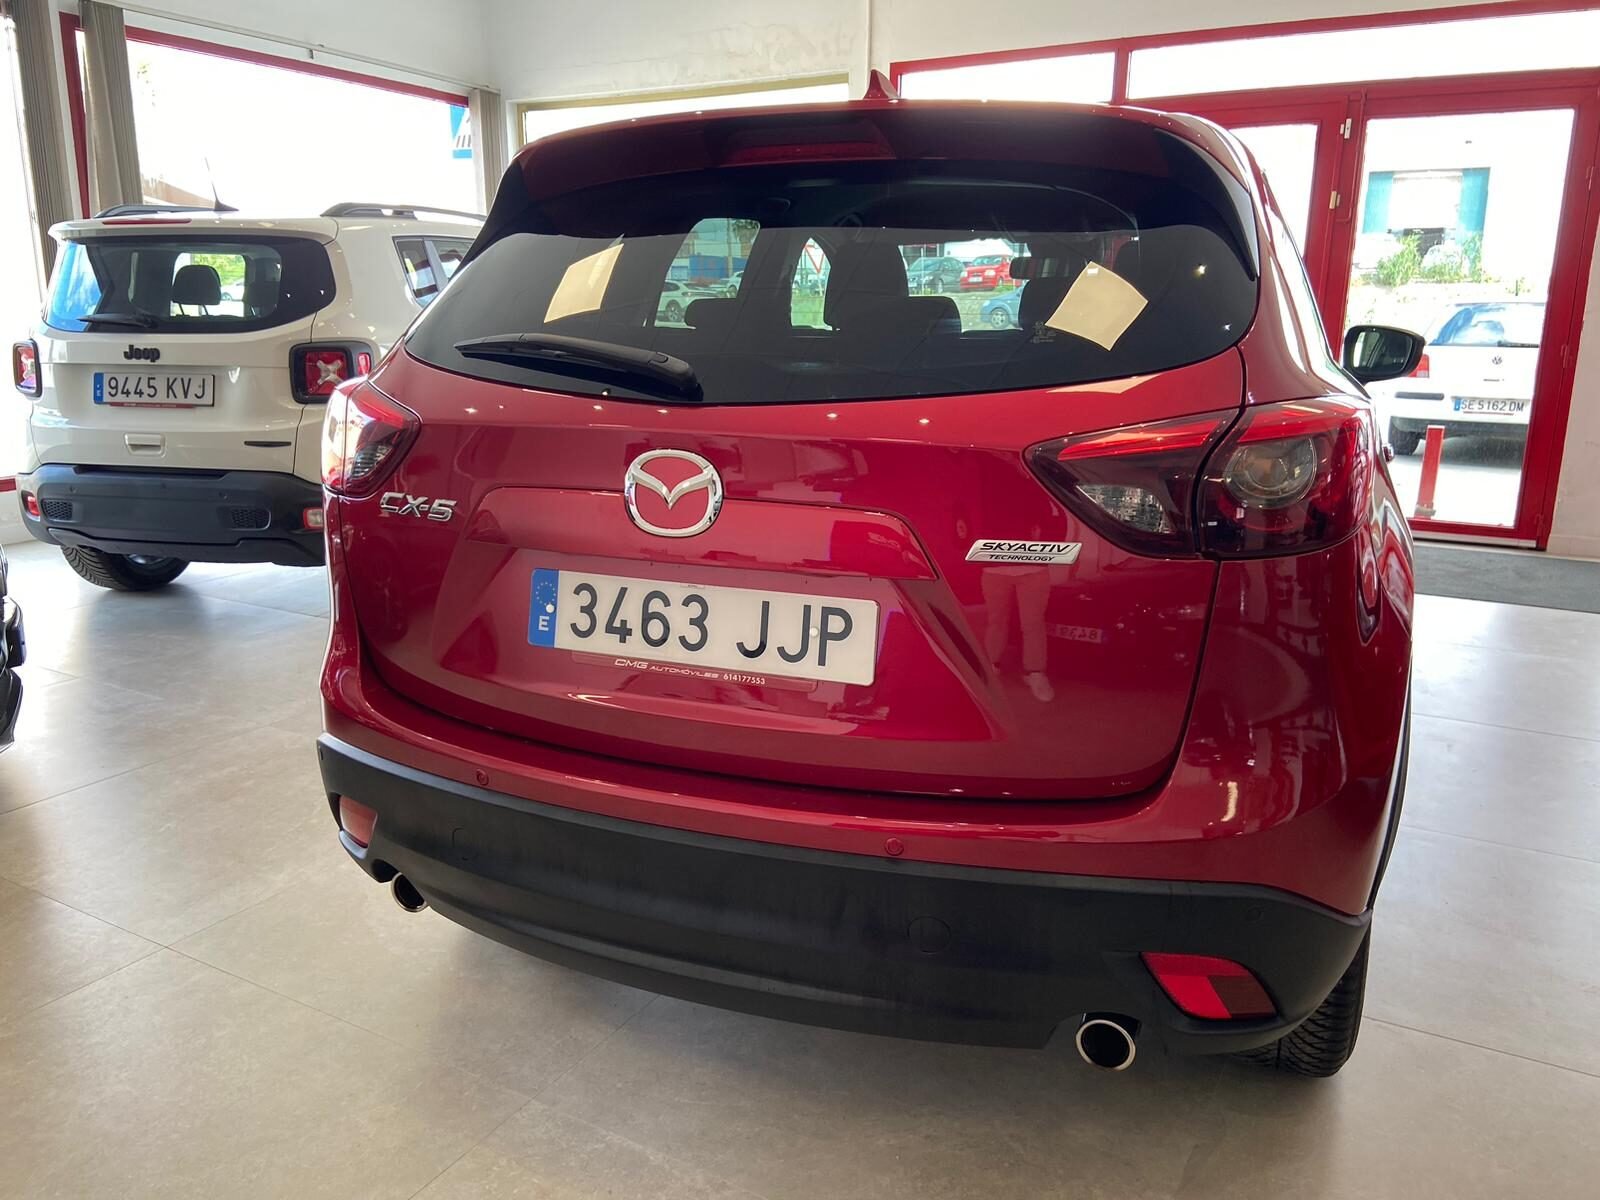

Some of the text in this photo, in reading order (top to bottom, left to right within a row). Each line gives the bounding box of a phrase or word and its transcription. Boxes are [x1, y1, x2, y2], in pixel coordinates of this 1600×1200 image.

[123, 344, 160, 362] Jeep
[108, 376, 206, 399] 9445 KVJ
[1461, 399, 1525, 412] SE 5162 DM
[380, 492, 457, 522] CX-5
[980, 542, 1070, 553] SKYACTIV
[989, 554, 1055, 562] TECHNOLOGY
[538, 616, 549, 631] E
[570, 582, 853, 667] 3463 JJP
[614, 658, 648, 669] CMG
[723, 673, 765, 685] 614177553
